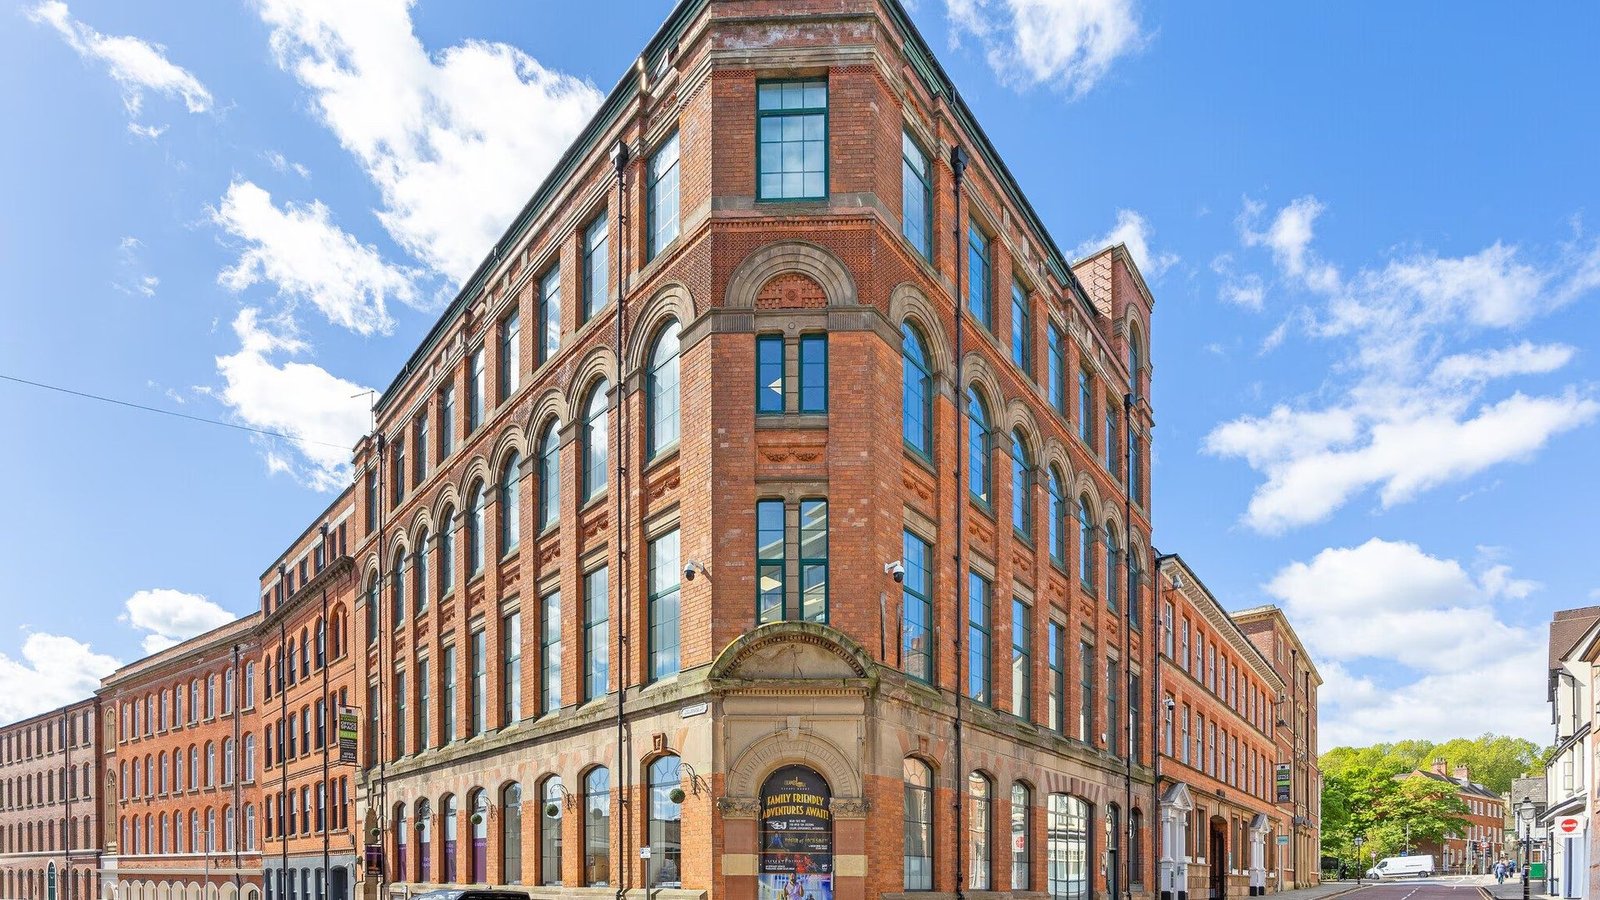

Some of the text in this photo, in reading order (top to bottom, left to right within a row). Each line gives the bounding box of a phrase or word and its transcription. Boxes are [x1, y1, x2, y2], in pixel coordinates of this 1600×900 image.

[767, 793, 824, 806] FAMILY FRIENDLY
[762, 805, 829, 820] ADVENTURES AWAIT!
